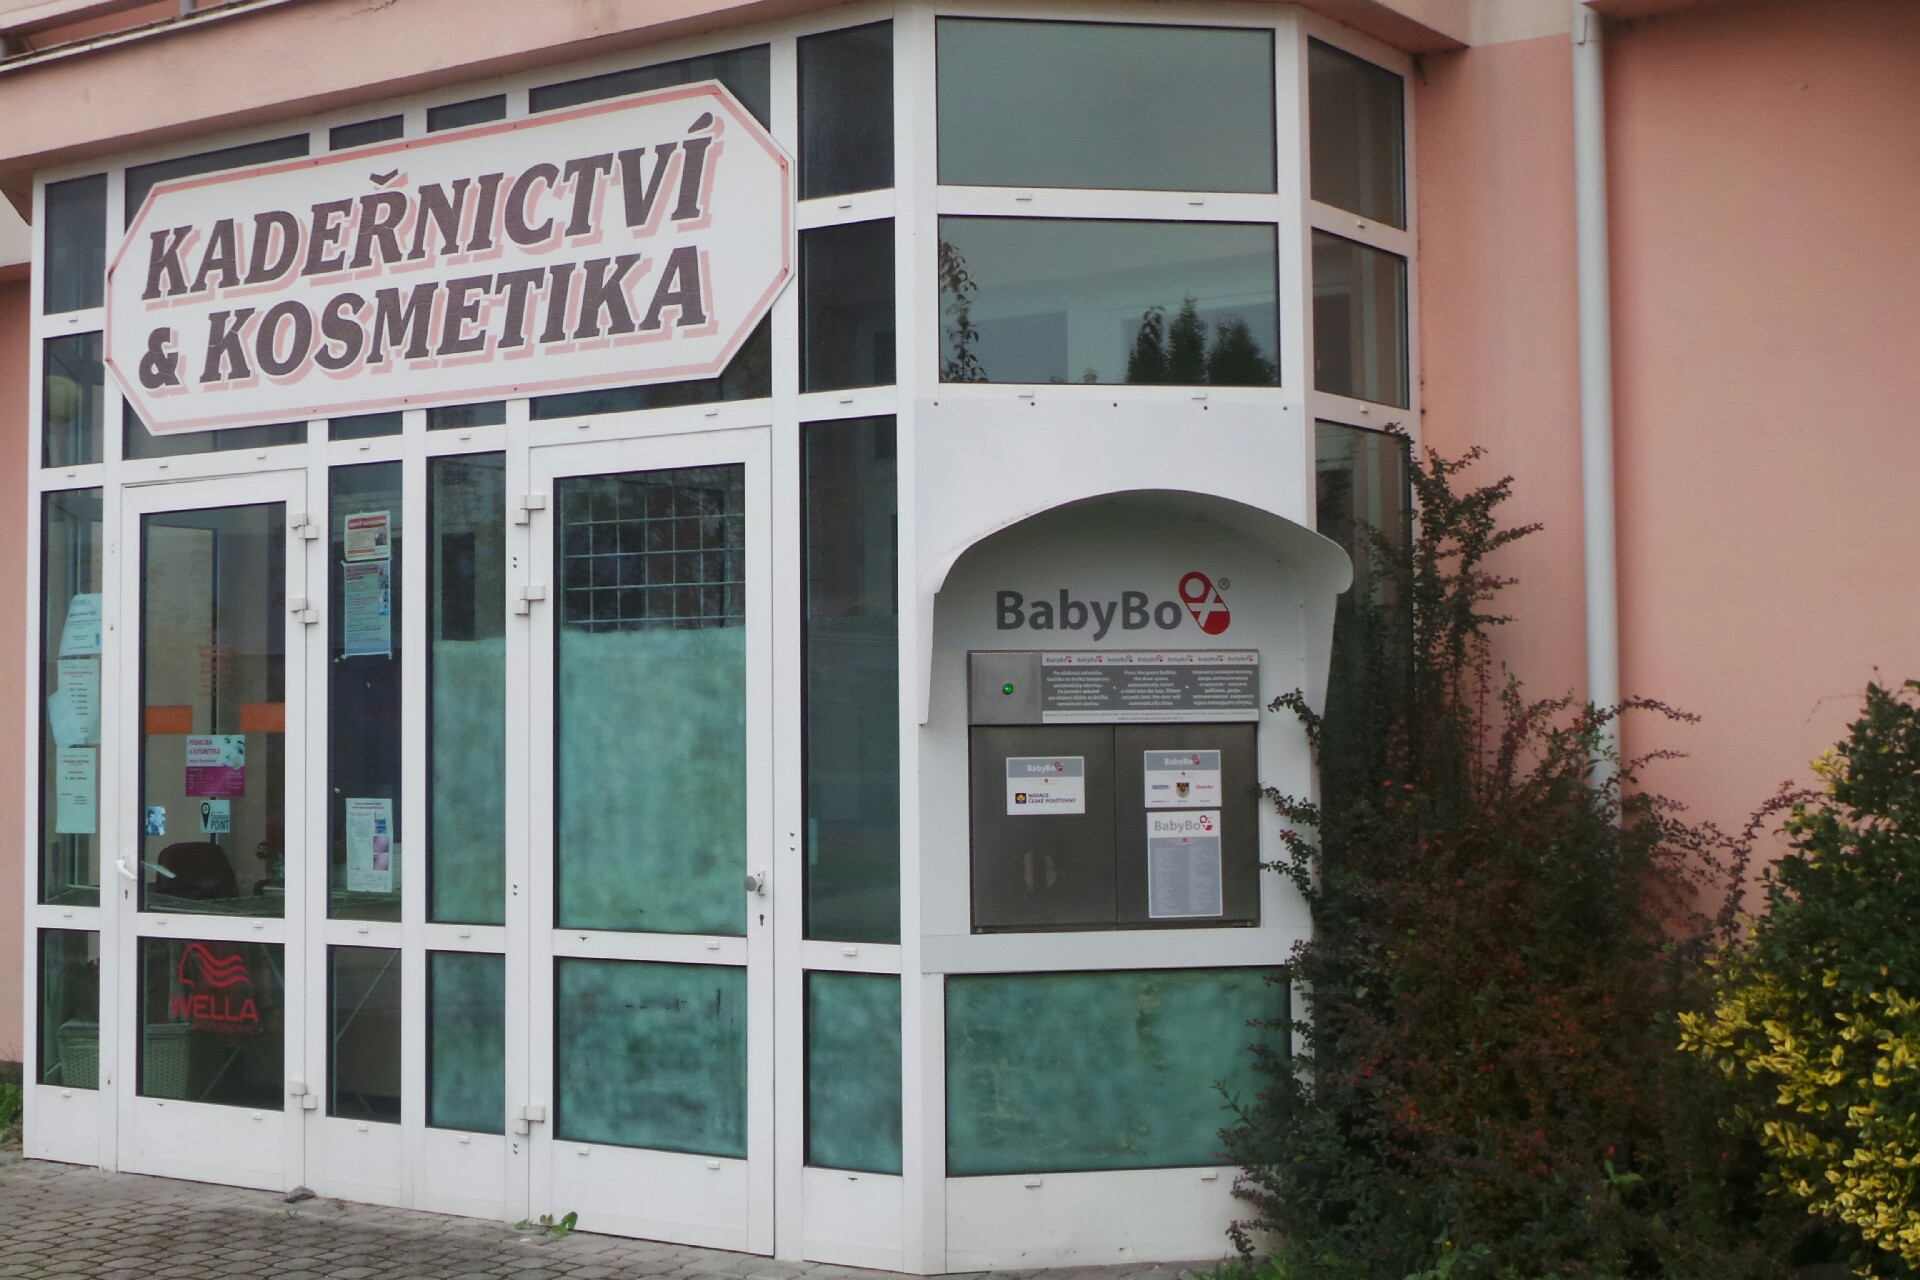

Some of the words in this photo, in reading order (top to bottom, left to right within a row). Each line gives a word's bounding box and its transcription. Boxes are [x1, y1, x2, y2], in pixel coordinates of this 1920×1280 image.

[142, 112, 713, 301] KADEŘNICTVÍ
[139, 327, 181, 389] &
[199, 245, 707, 385] KOSMETIKA
[210, 819, 229, 831] POINT
[169, 992, 260, 1023] WELLA
